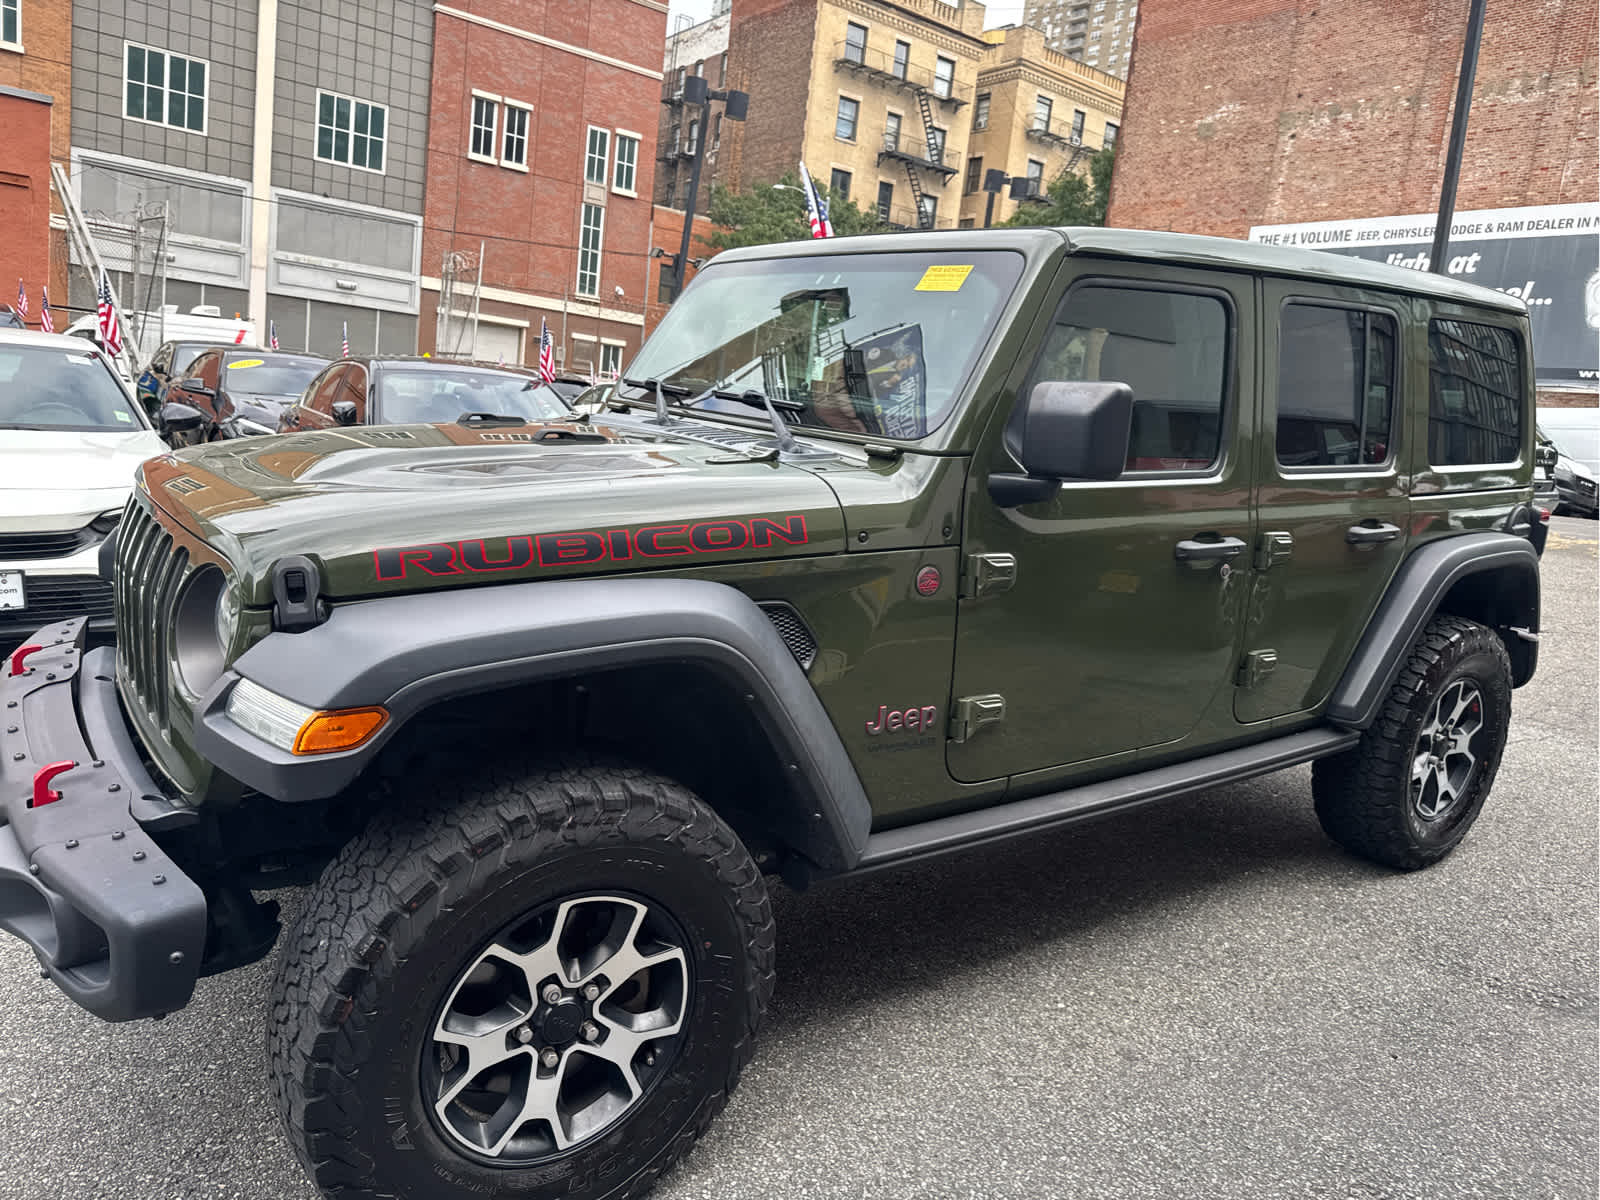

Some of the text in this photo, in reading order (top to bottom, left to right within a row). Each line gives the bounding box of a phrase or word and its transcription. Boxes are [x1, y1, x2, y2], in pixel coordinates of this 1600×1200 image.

[1259, 233, 1281, 246] THE
[1282, 232, 1297, 245] #1
[1301, 229, 1353, 244] VOLUME
[1450, 223, 1482, 236] ODGE
[1484, 223, 1494, 233] &
[1496, 220, 1524, 233] RAM
[1526, 218, 1575, 231] DEALER
[1576, 216, 1591, 228] IN
[1447, 252, 1481, 274] at
[374, 515, 809, 582] RUBICON
[865, 705, 937, 736] Jeep
